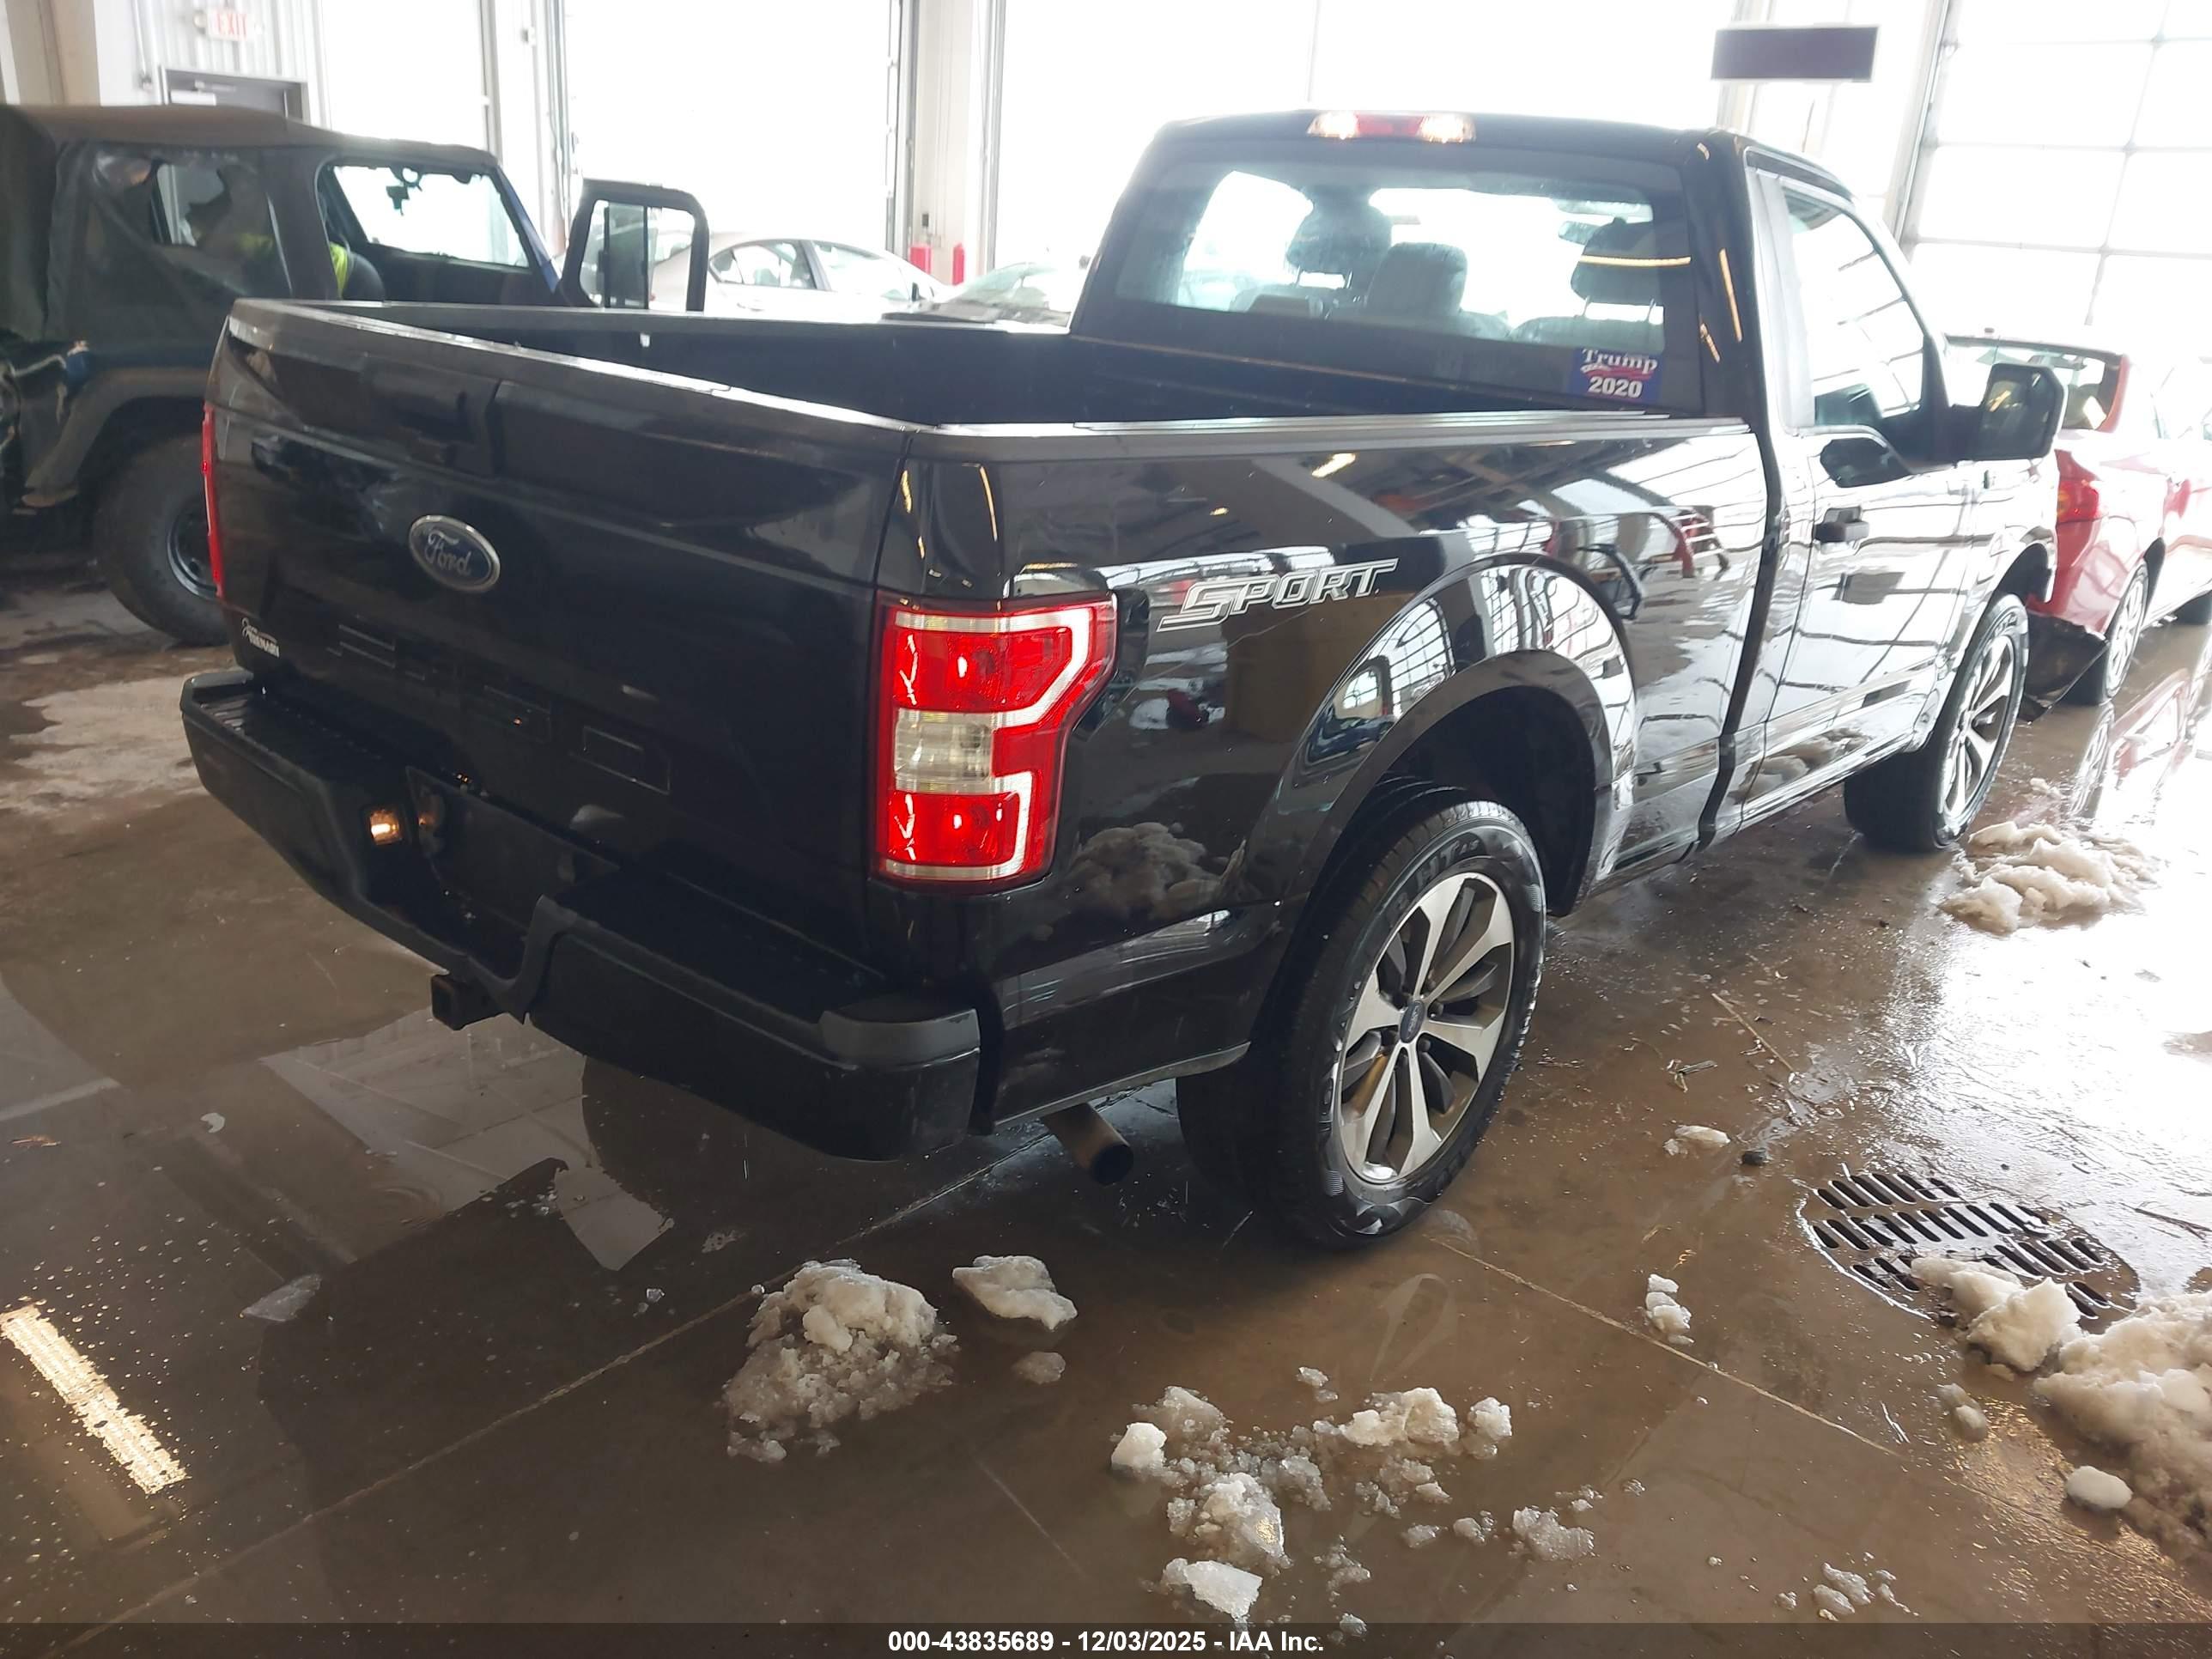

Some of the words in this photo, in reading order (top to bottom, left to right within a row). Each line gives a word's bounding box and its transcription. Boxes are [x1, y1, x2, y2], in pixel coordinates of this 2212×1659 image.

[1582, 348, 1658, 375] Trump
[1588, 376, 1644, 398] 2020
[424, 529, 473, 576] Ford
[1156, 557, 1400, 632] SPORT
